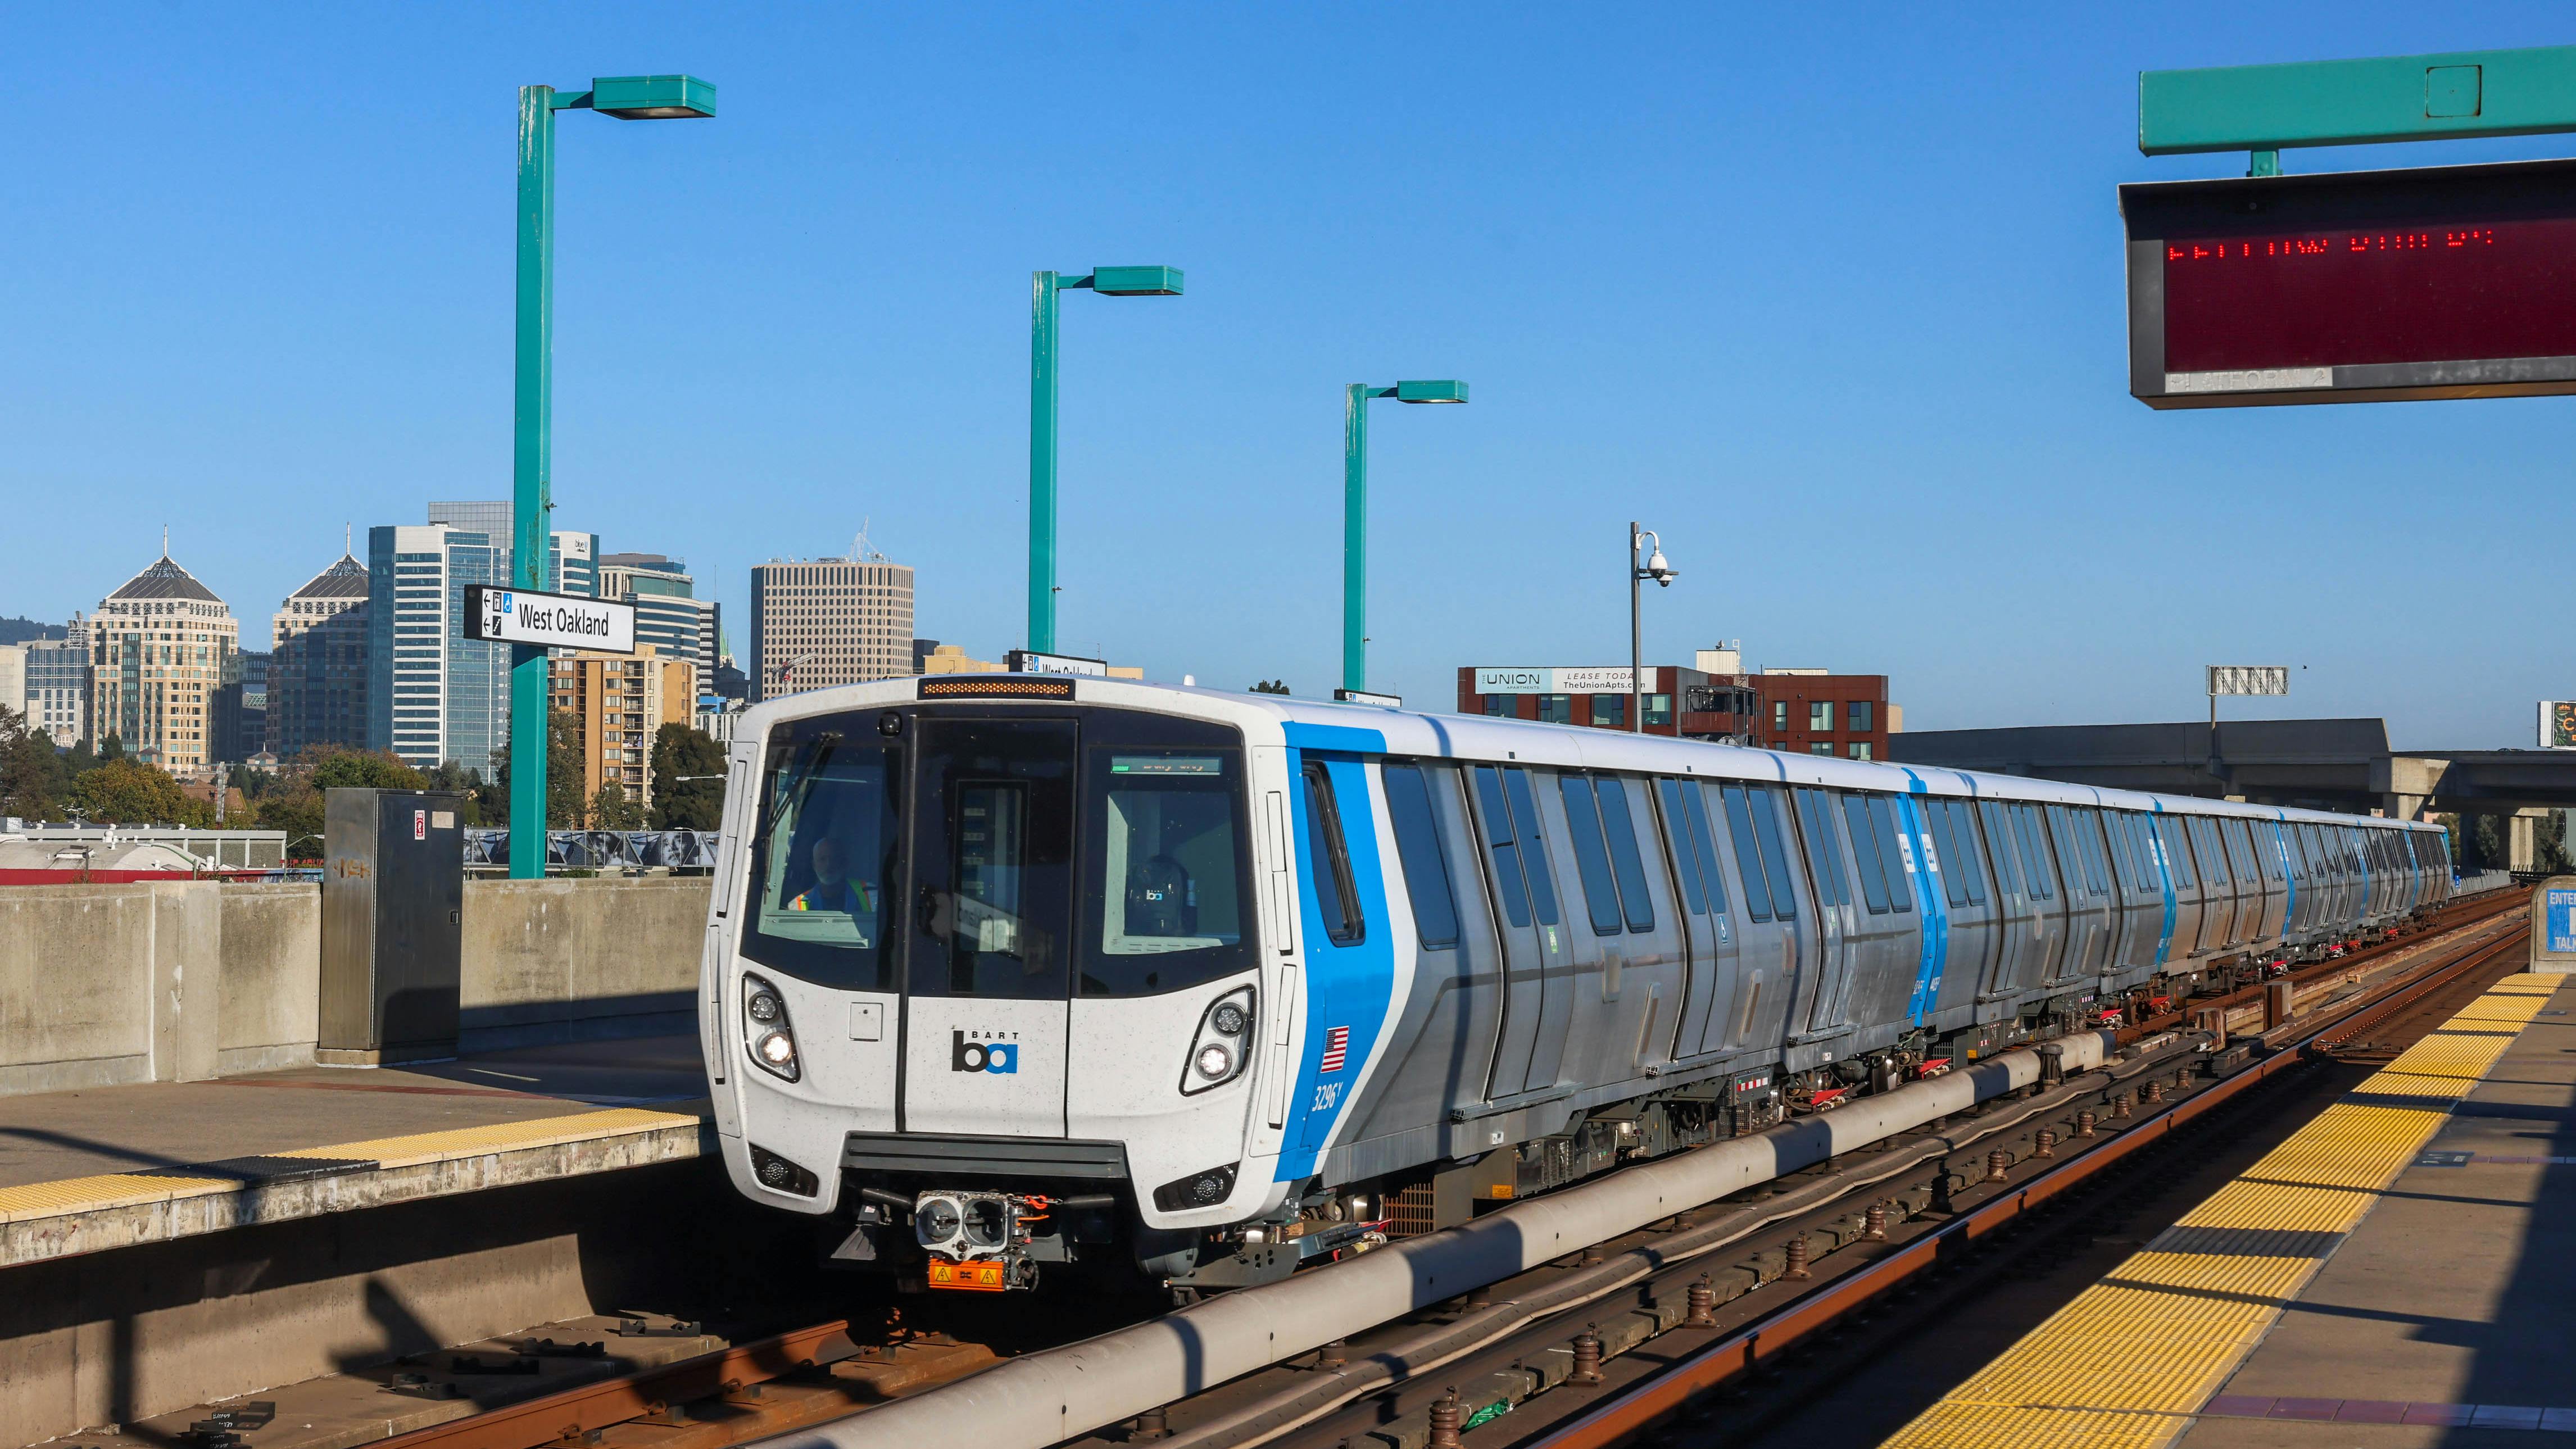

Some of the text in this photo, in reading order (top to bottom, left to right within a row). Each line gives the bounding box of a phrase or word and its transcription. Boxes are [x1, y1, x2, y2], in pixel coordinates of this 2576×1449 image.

[519, 603, 609, 637] West Oakland
[1487, 674, 1540, 684] UNION
[1563, 681, 1646, 692] TheUnionApts.cm
[2550, 892, 2576, 905] ENTE
[951, 1030, 1018, 1074] ba
